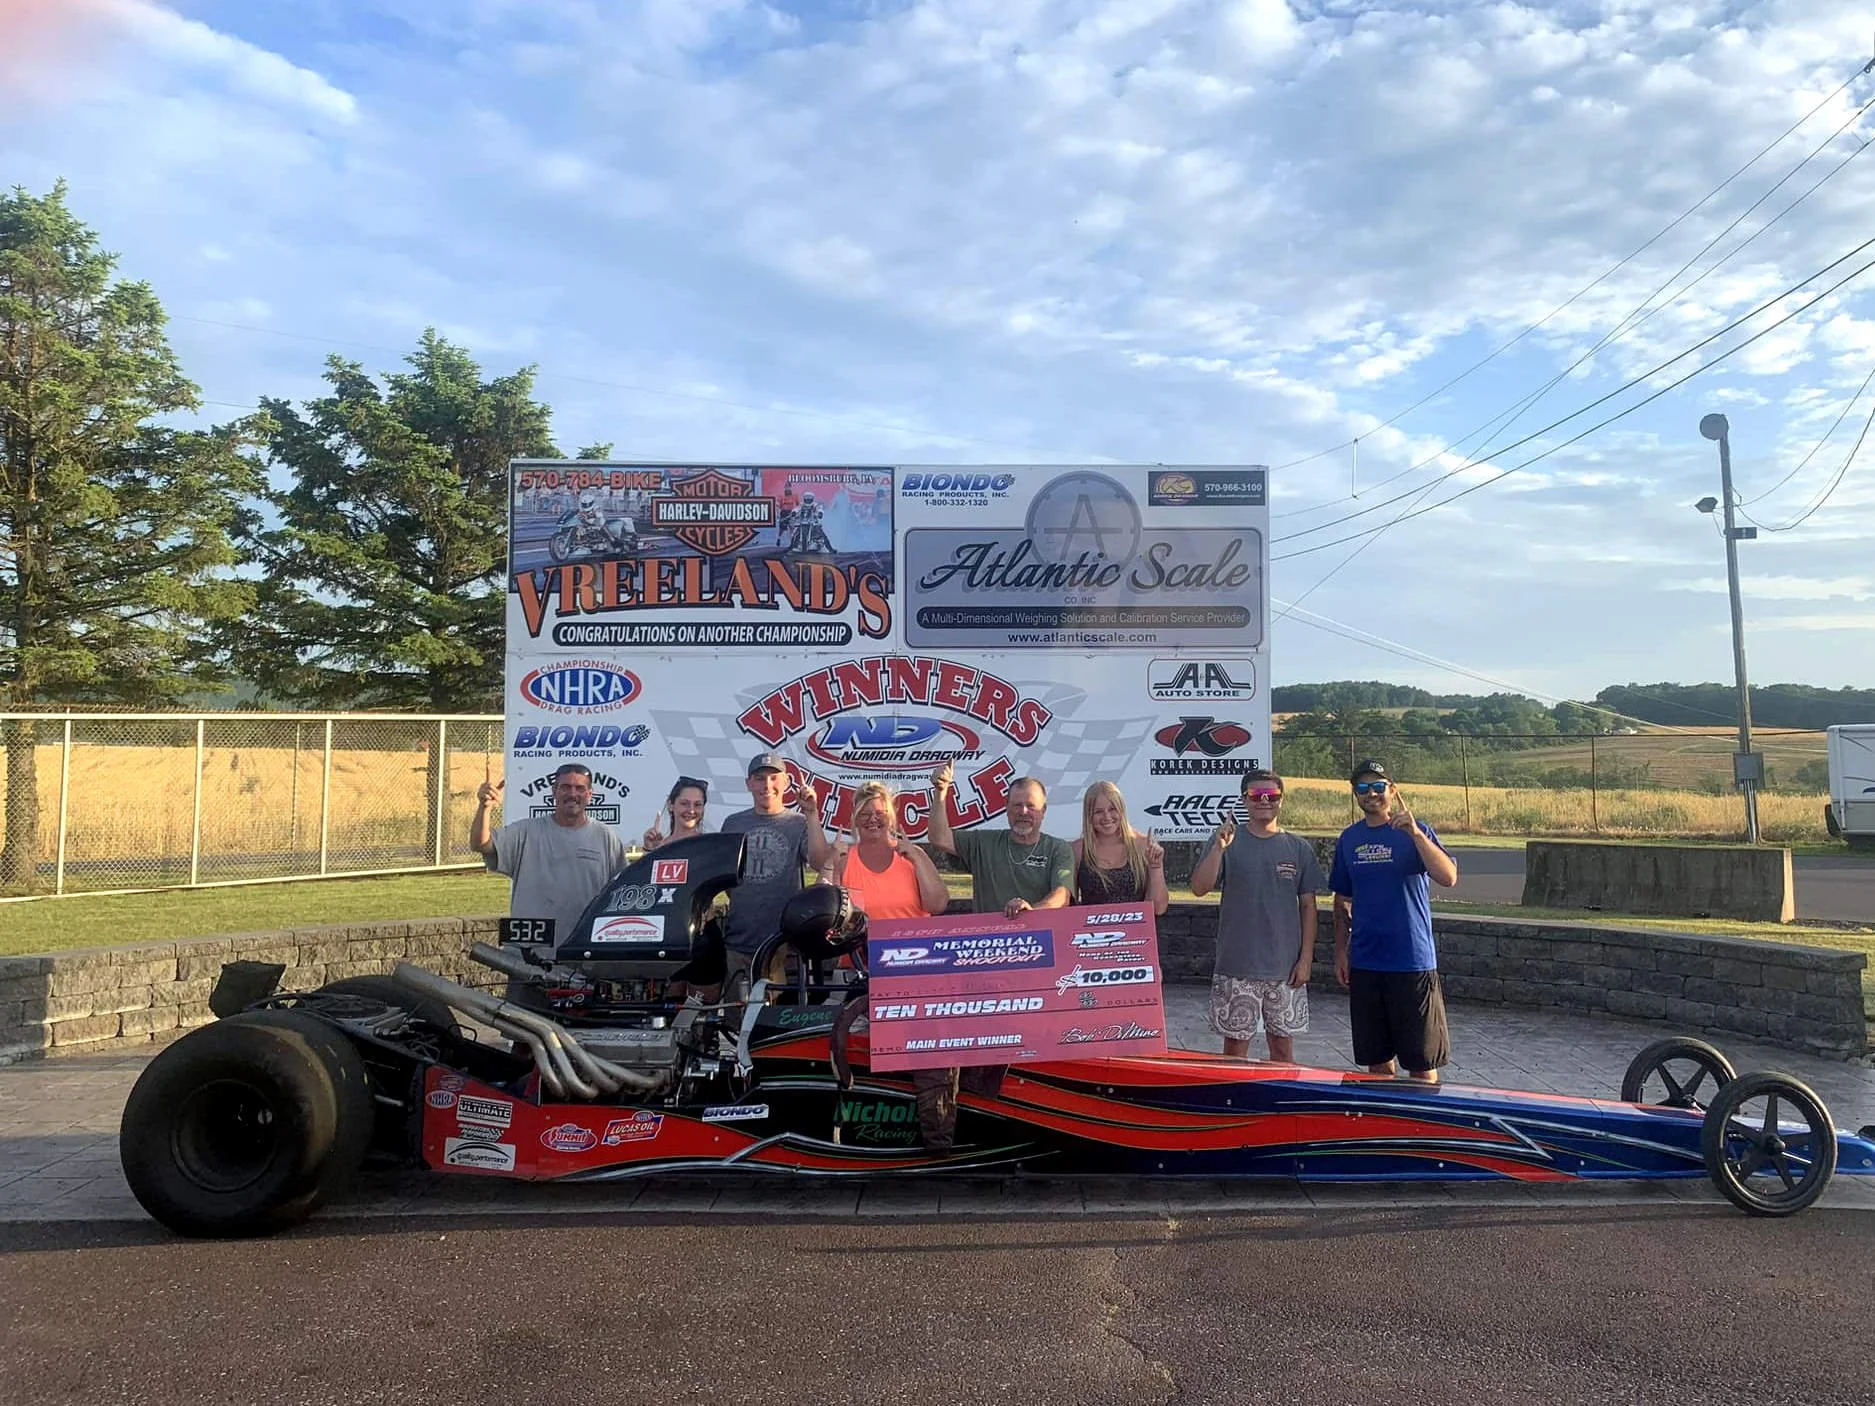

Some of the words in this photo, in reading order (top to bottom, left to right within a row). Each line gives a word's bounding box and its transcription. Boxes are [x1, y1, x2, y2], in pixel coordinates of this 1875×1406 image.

[520, 470, 663, 490] 570-784-BIKE
[902, 474, 1010, 491] BIONDO
[682, 483, 744, 497] MOTOR
[939, 491, 987, 499] PRODUCTS,
[924, 499, 988, 507] 1-800-332-1320
[659, 502, 769, 522] HARLEY-DAVIDSON
[684, 526, 746, 549] CYCLES
[919, 539, 1122, 592] Atlantic
[1130, 538, 1252, 590] Scale
[514, 556, 893, 640] VREELAND'S
[922, 614, 930, 623] A
[931, 613, 1013, 624] Multi-Dimensional
[1015, 613, 1058, 626] Weighing
[1060, 613, 1097, 624] Solution
[1100, 613, 1117, 624] and
[1119, 613, 1163, 624] Calibration
[1166, 613, 1203, 624] Service
[1206, 613, 1246, 624] Provider
[559, 626, 676, 643] CONGRATULATIONS
[678, 626, 695, 642] ON
[697, 626, 755, 642] ANOTHER
[757, 626, 847, 642] CHAMPIONSHIP
[1008, 632, 1157, 644] www.atlanticscale.com
[540, 659, 624, 675] CHAMPIONSHIP
[540, 670, 625, 704] NHRA
[540, 701, 572, 715] DRAG
[577, 701, 623, 716] RACING
[736, 655, 1053, 748] WINNERS
[513, 726, 641, 748] BIONDO
[820, 716, 943, 749] ND
[513, 750, 553, 758] RACING
[558, 750, 617, 759] PRODUCTS,
[839, 750, 907, 761] NUMIDIA
[908, 750, 986, 761] DRAGWAY
[1151, 760, 1193, 769] KOREK
[1201, 760, 1258, 769] DESIGNS
[520, 772, 631, 798] VREND'S
[1162, 795, 1239, 809] RACE
[661, 864, 684, 879] LV
[1086, 912, 1144, 925] 5/28/23
[509, 920, 546, 941] 532
[933, 936, 1038, 950] MEMORIAL
[957, 945, 1044, 958] WEEKEND
[952, 953, 1047, 967] SHOOTOUT
[874, 1004, 918, 1019] TEN
[924, 997, 1044, 1017] THOUSAND
[778, 1008, 833, 1026] Eugene
[906, 1039, 936, 1050] MAIN
[938, 1037, 975, 1048] EVENT
[977, 1034, 1023, 1046] WINNER
[459, 1100, 511, 1118] ULTIMATE
[703, 1104, 767, 1118] BIONDO
[610, 1123, 640, 1135] LUCAS
[640, 1121, 655, 1131] OIL
[853, 1123, 918, 1145] Racing
